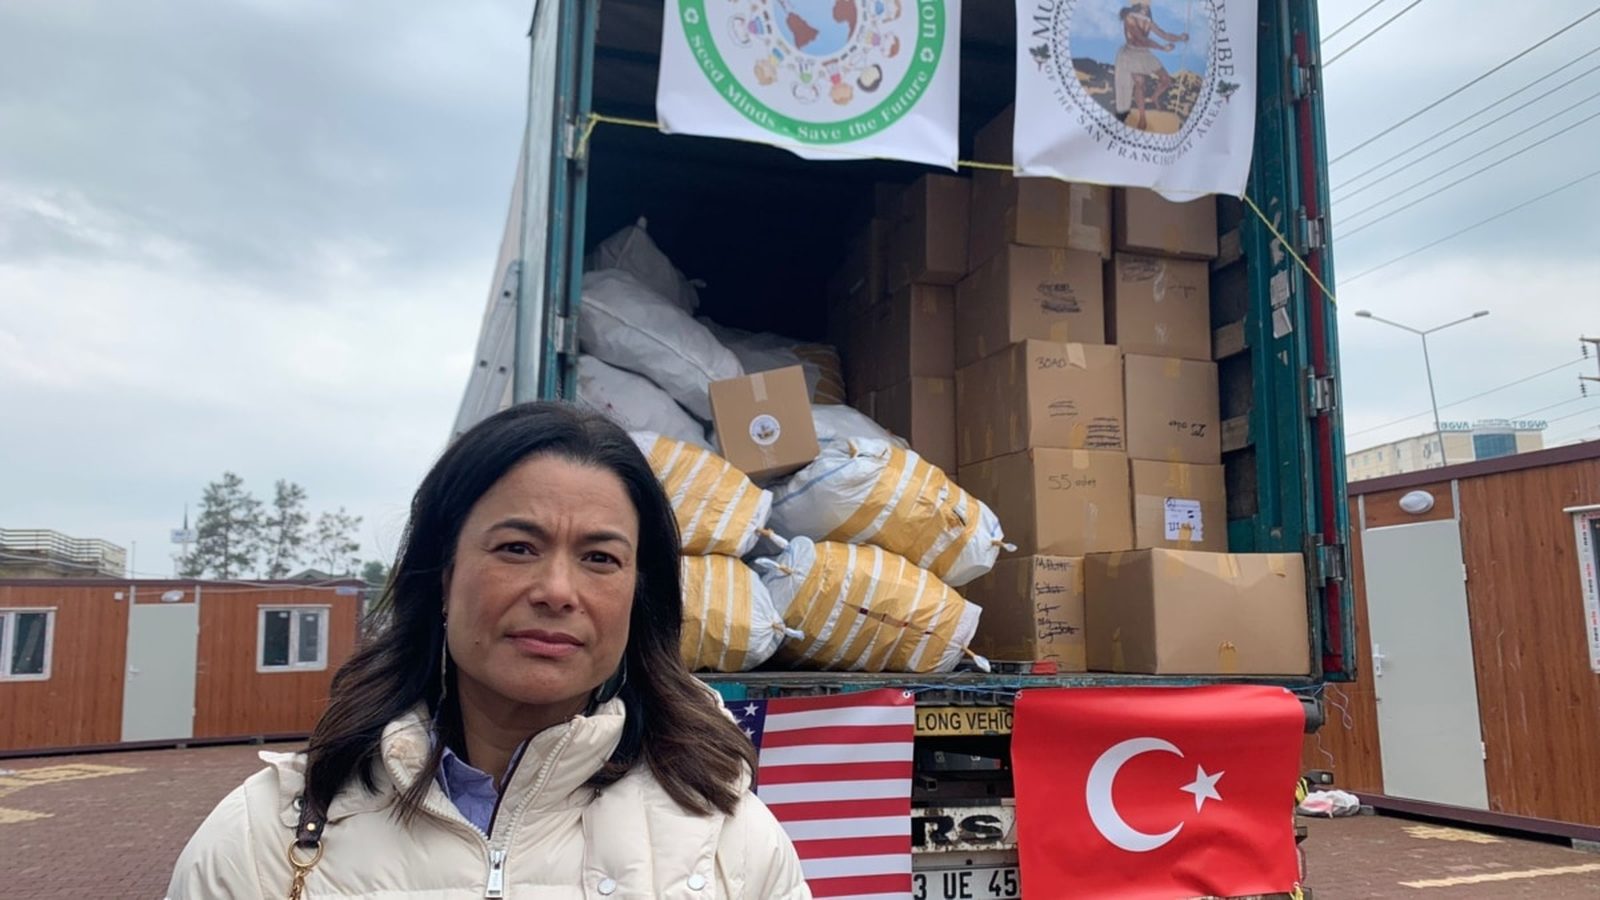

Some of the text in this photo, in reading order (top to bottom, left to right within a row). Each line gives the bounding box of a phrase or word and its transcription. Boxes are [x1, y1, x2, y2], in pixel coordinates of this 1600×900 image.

[1216, 0, 1234, 77] TRIBE
[724, 84, 776, 128] Minds
[797, 125, 841, 140] Save
[848, 119, 877, 137] the
[881, 70, 927, 121] Future
[1044, 64, 1057, 80] OF
[1054, 88, 1075, 113] THE
[1076, 114, 1104, 142] SAN
[1197, 98, 1223, 138] AREA
[1048, 473, 1072, 491] 55
[916, 711, 1013, 731] LONG VEHIC
[943, 871, 972, 900] UE
[989, 869, 1017, 897] 45
